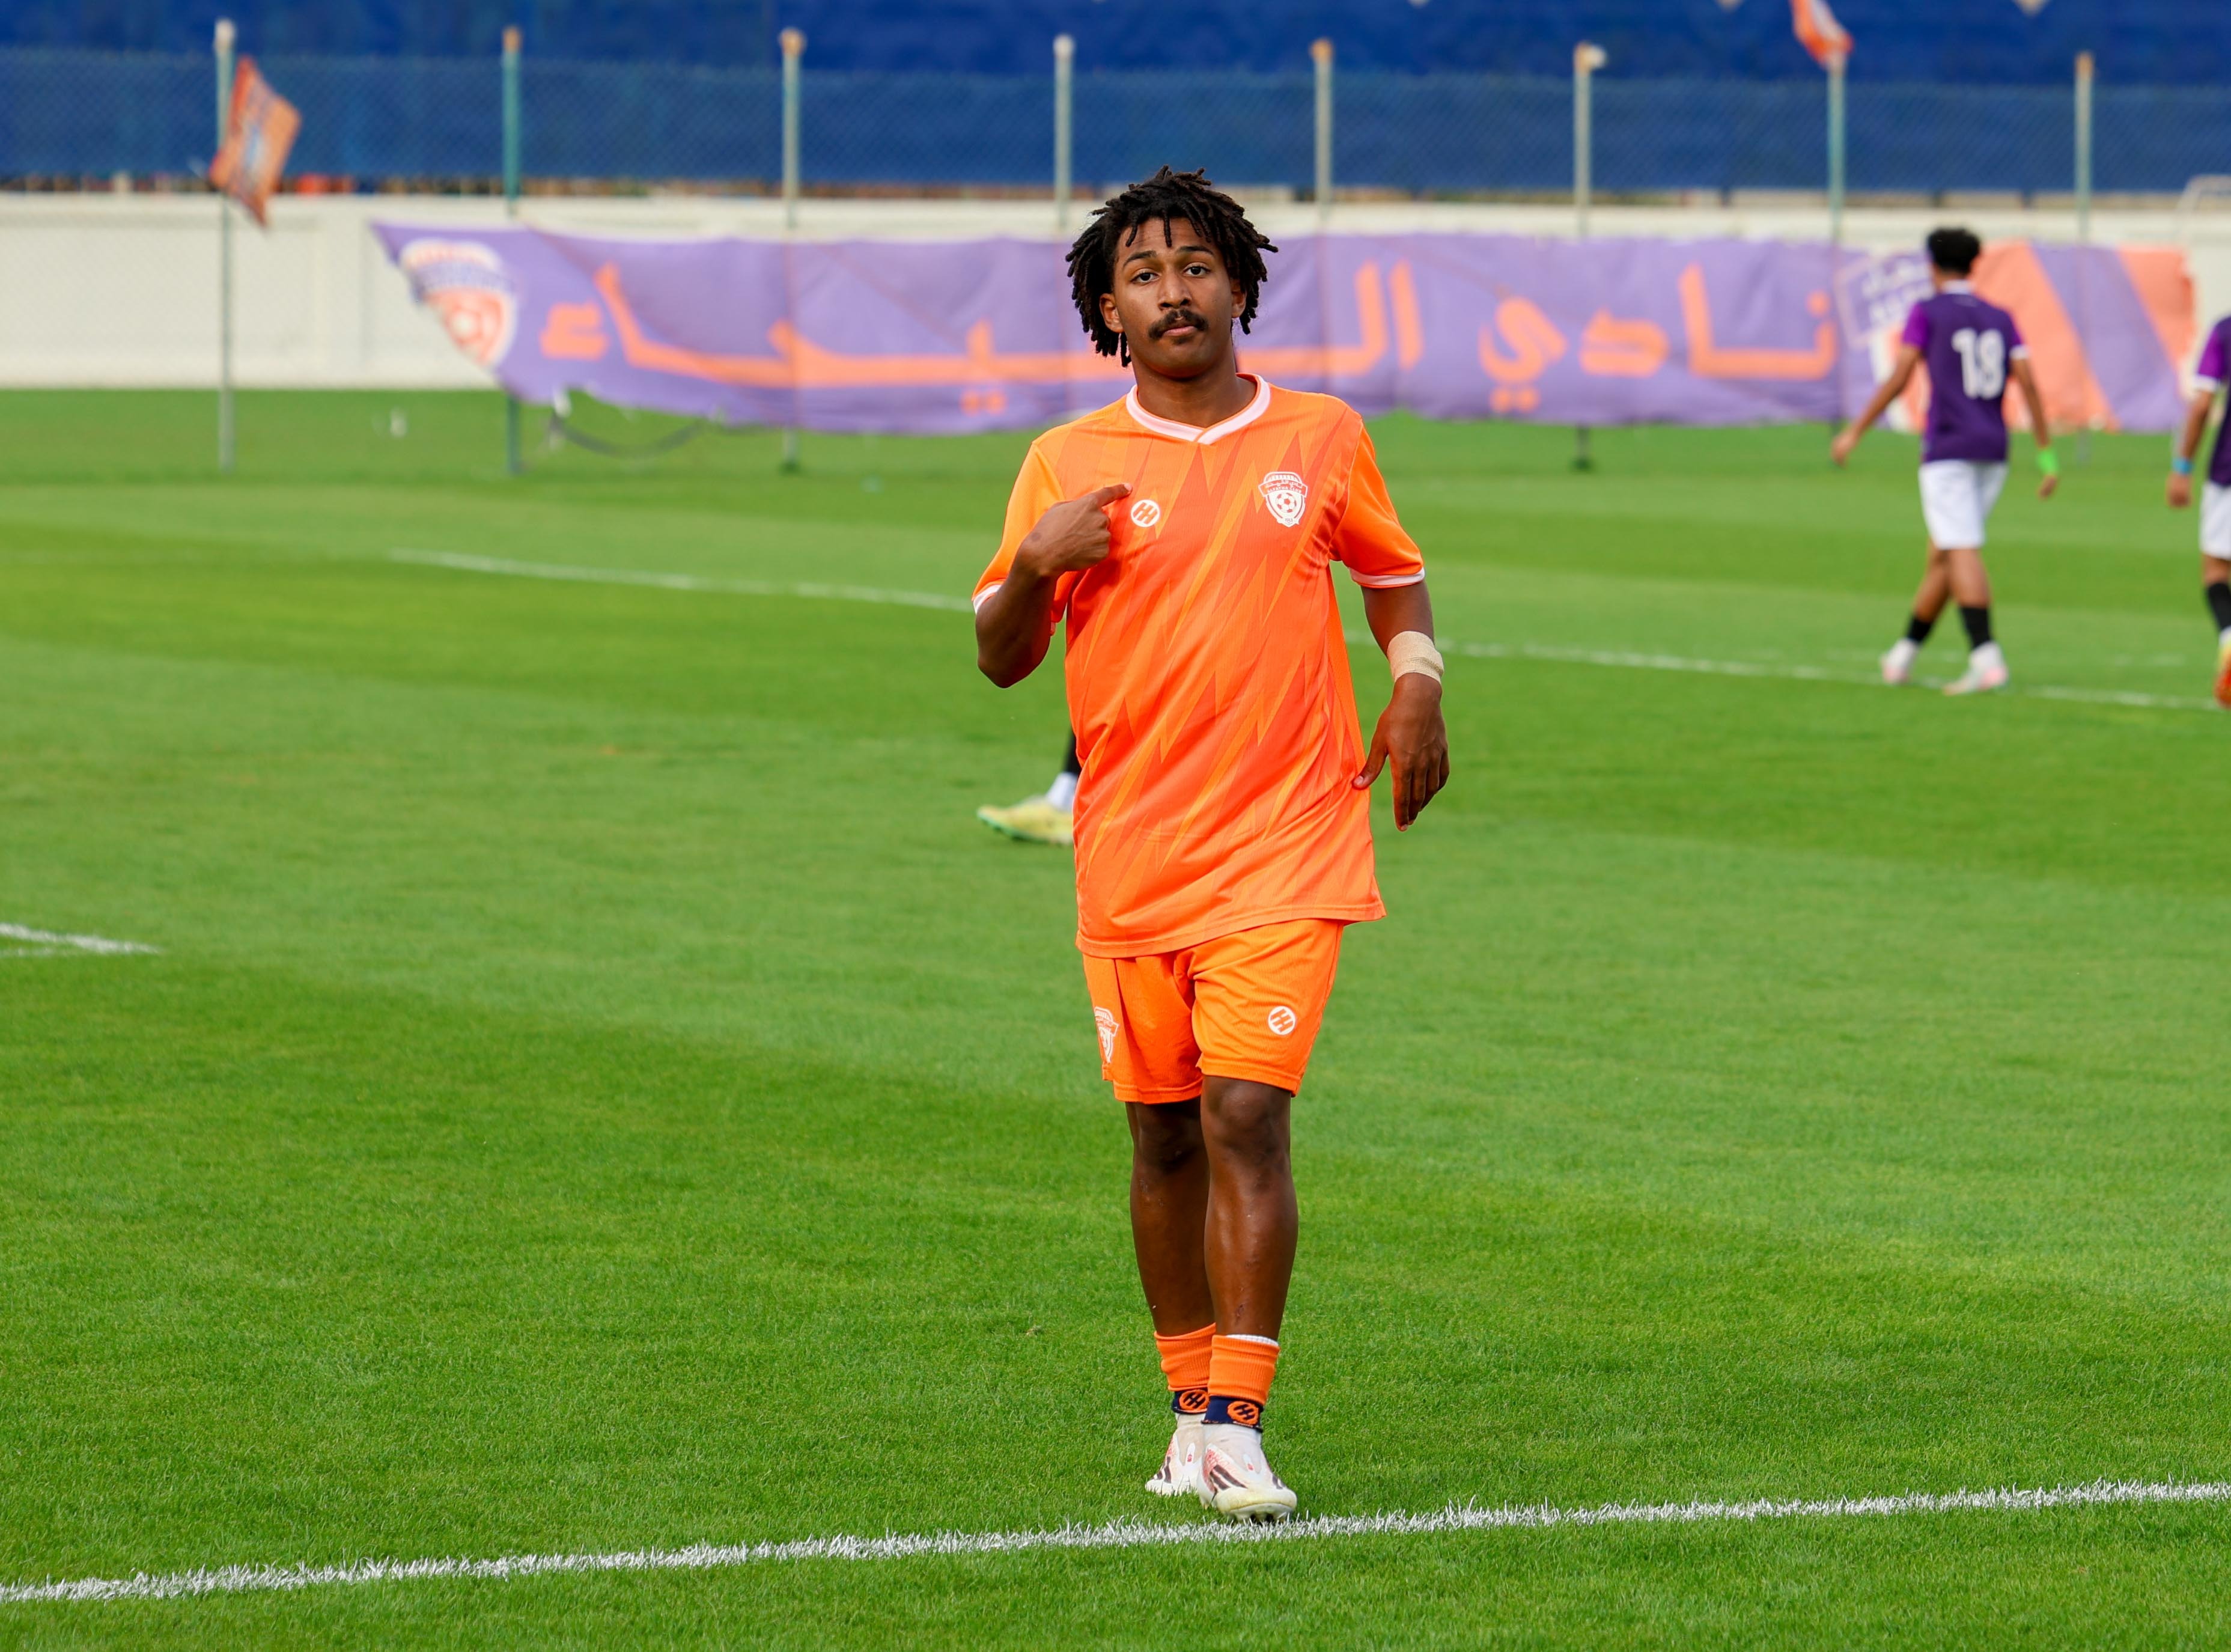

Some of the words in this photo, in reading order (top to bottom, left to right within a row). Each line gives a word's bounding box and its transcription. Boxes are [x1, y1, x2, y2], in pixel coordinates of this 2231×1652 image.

[541, 260, 1423, 415] اليحاء
[1479, 263, 1836, 414] نادي
[1950, 326, 2006, 401] 19
